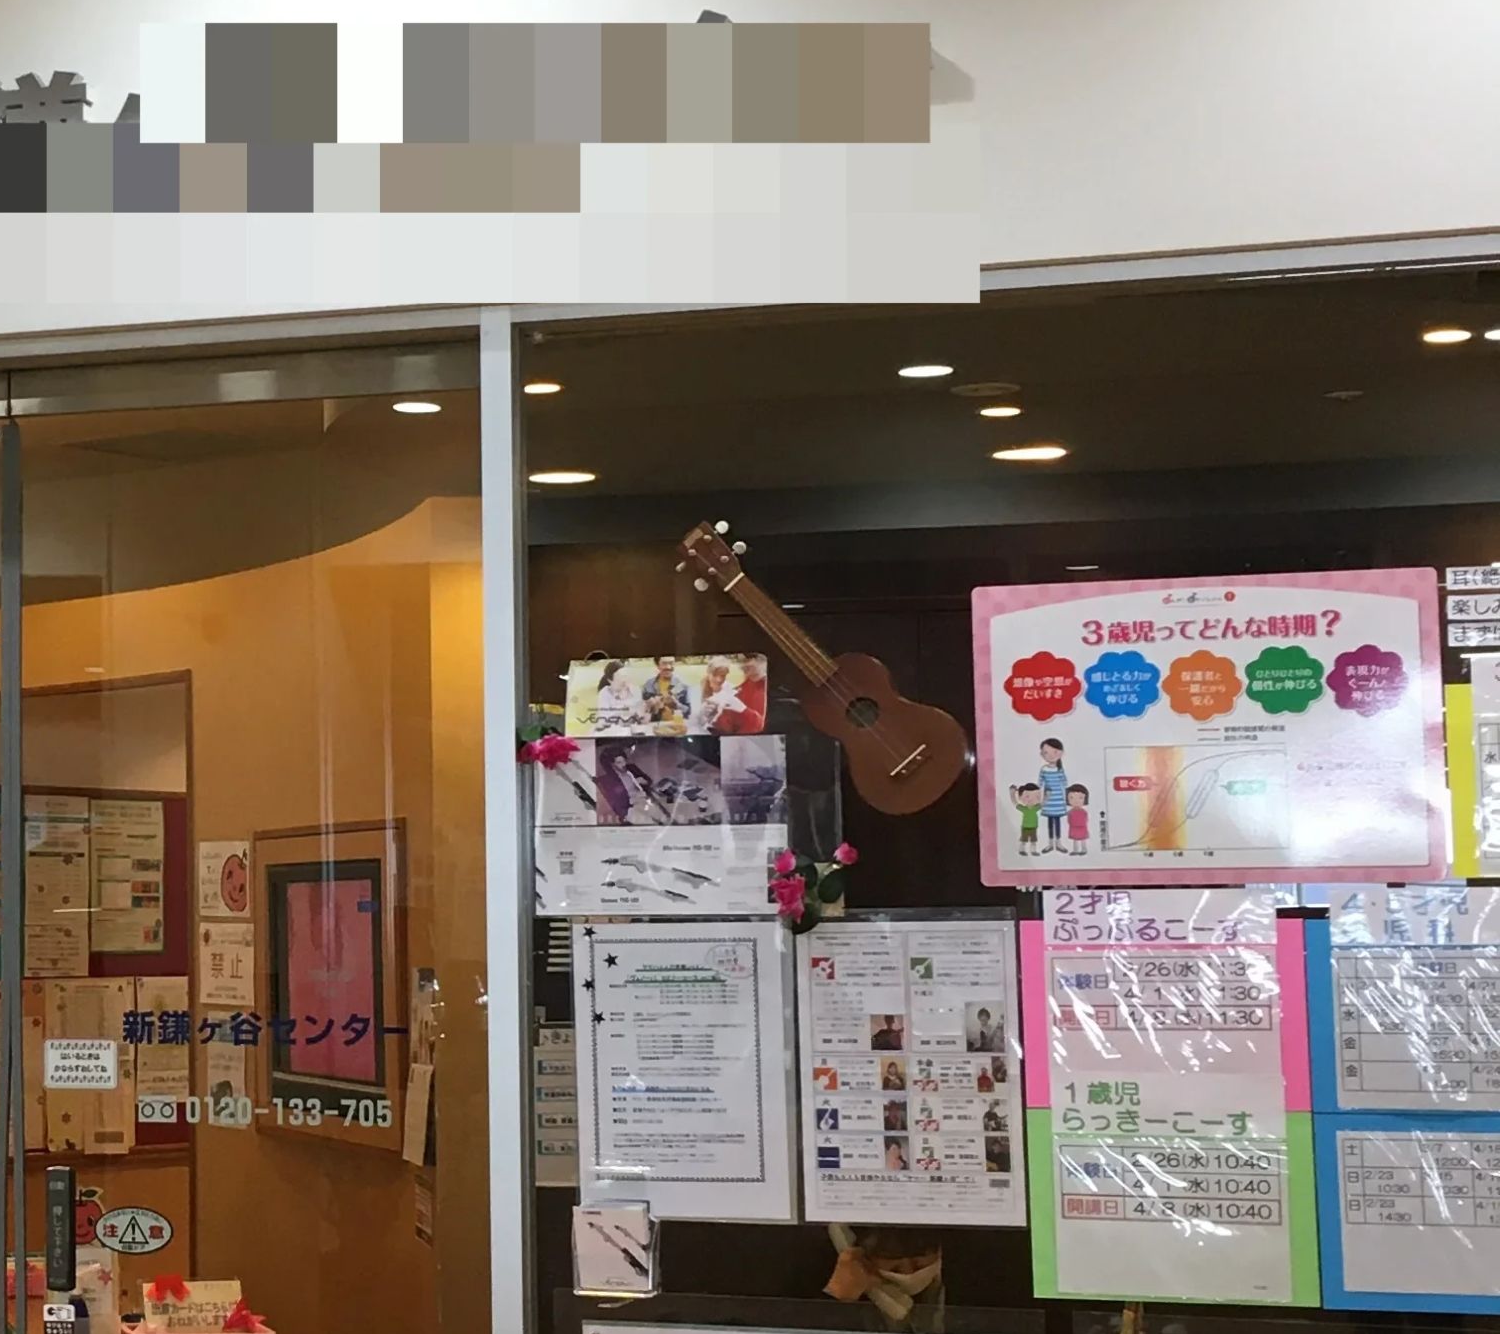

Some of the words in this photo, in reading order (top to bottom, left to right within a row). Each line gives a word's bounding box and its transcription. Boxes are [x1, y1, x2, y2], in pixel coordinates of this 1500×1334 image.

[1081, 610, 1341, 646] 3歳児ってどんな時期？
[211, 953, 243, 979] 禁止
[122, 1010, 409, 1046] 新鎌ヶ谷センター
[1065, 1081, 1141, 1106] 1歳児
[186, 1096, 393, 1127] 0120-133-705
[1063, 1108, 1253, 1136] らっきーこーす
